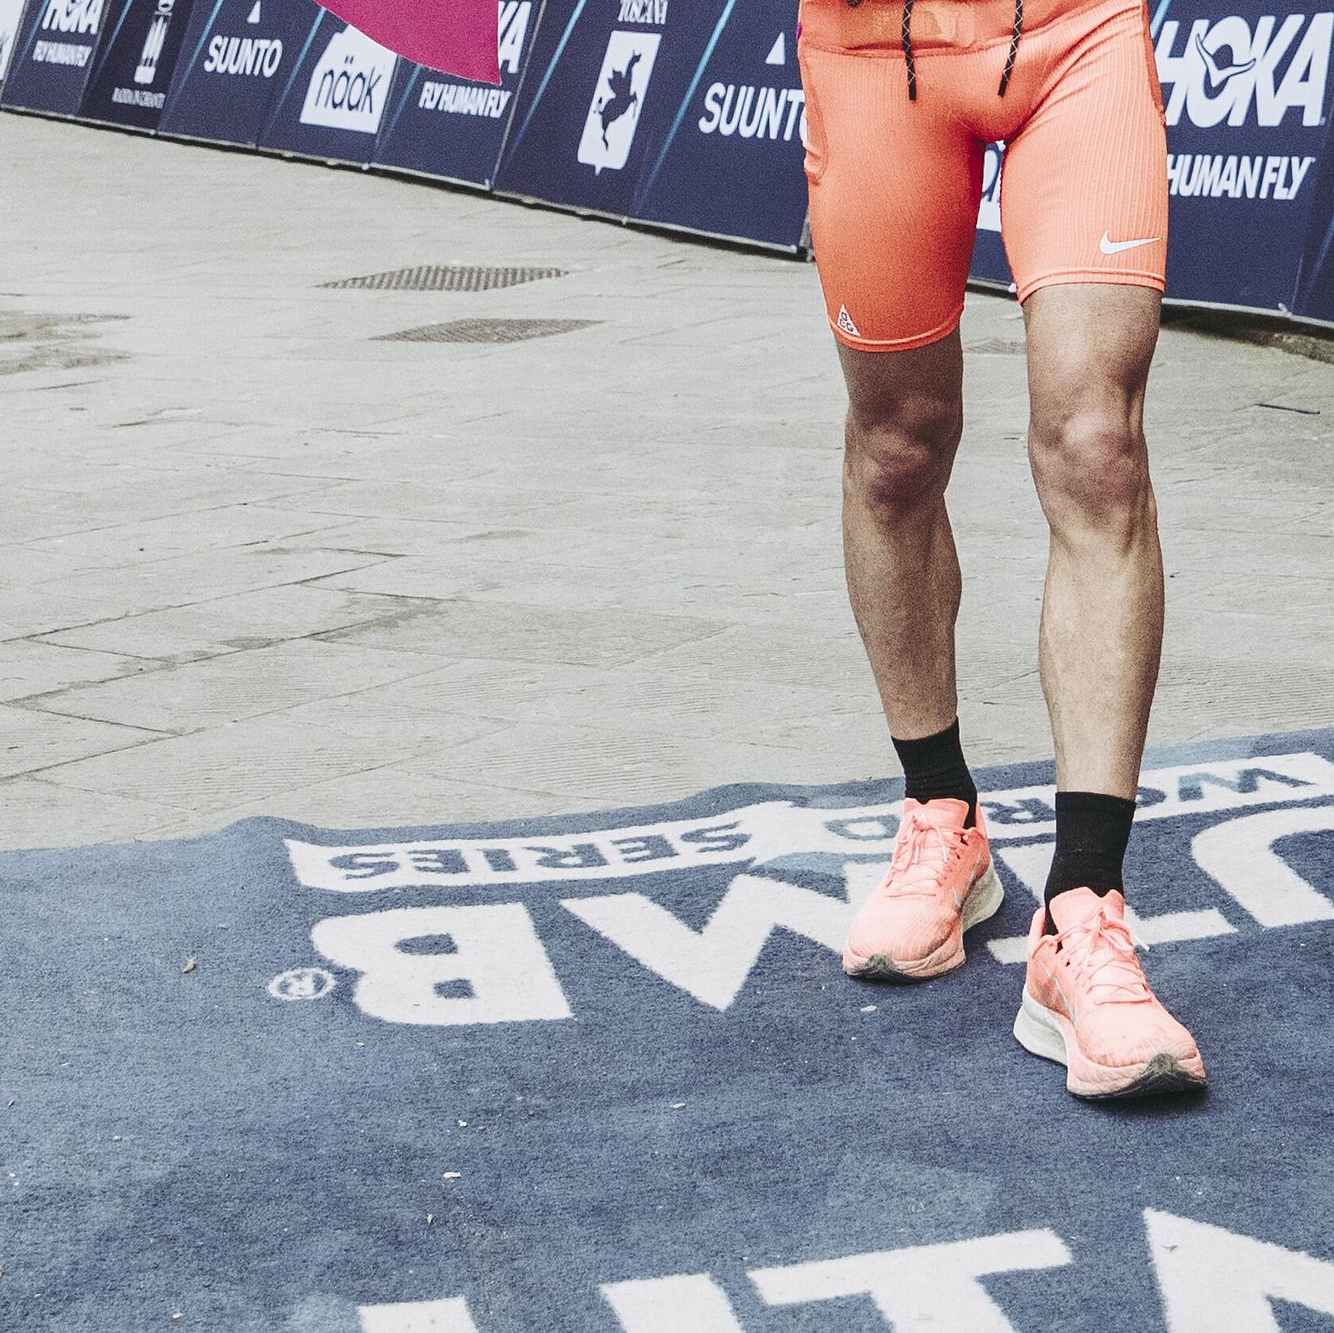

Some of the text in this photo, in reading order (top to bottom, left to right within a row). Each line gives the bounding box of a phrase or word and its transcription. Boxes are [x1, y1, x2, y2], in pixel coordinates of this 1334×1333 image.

[203, 35, 283, 78] SUUNTO
[314, 55, 383, 114] näak
[1154, 12, 1334, 128] HOKA
[1167, 153, 1316, 200] HUMAN FLY
[327, 819, 758, 879] SERIES
